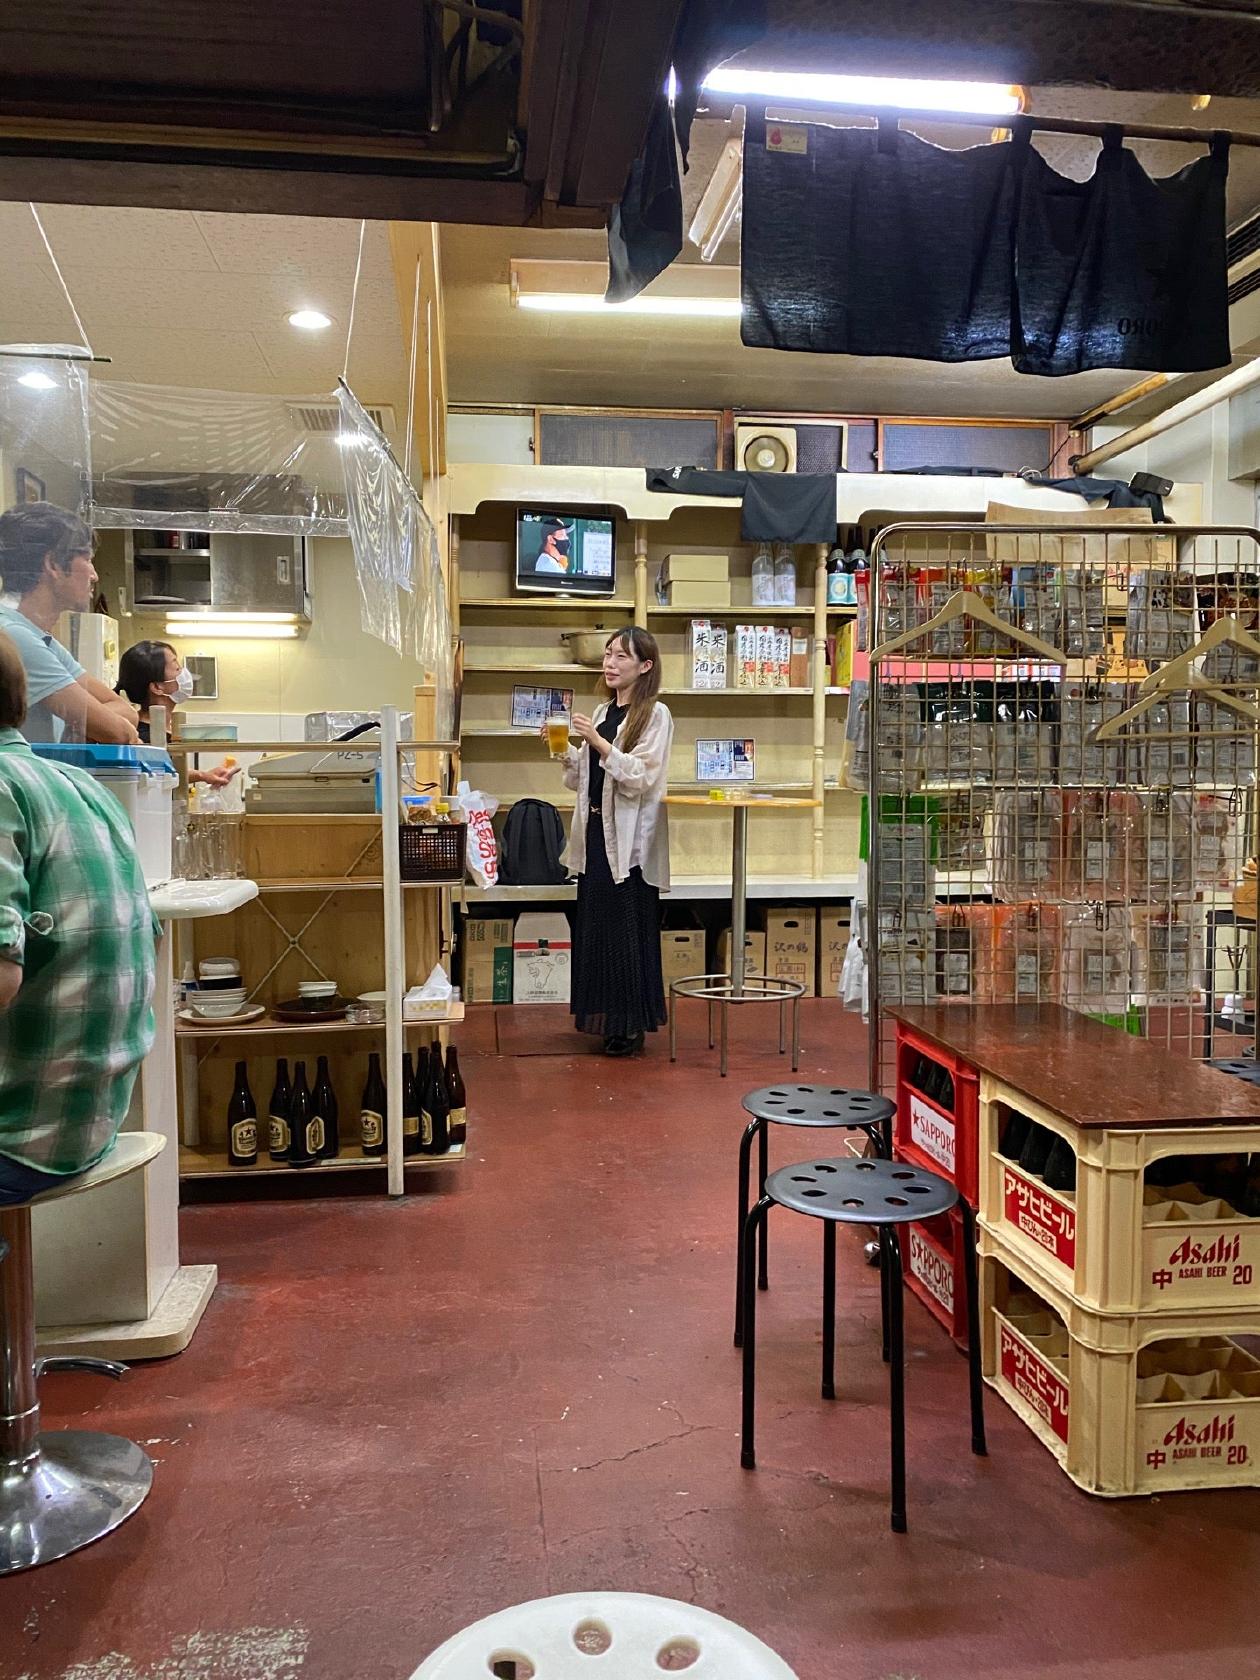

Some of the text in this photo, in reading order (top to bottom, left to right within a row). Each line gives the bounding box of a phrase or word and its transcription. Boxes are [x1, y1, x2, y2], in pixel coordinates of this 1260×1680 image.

[1005, 1172, 1075, 1240] アサヒビール
[1168, 1233, 1240, 1265] Asahi
[1152, 1264, 1253, 1290] 中 ASAHI BEER 20
[1002, 1331, 1069, 1416] アサヒビール
[1163, 1414, 1236, 1446] Asahi
[1146, 1444, 1248, 1470] 中 ASAHI BEER 20
